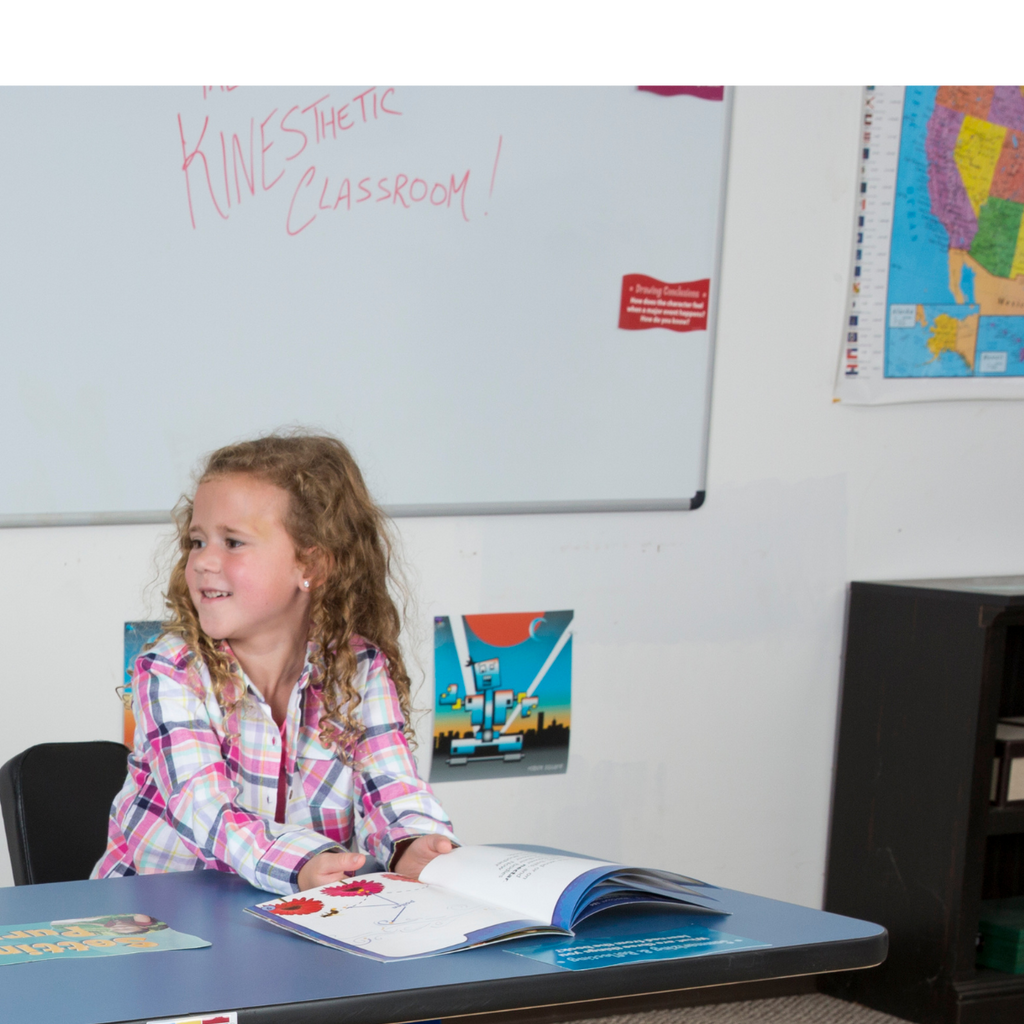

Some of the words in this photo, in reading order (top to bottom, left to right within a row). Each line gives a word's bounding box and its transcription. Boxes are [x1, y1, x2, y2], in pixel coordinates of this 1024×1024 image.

[177, 86, 403, 230] KINESTHETIC
[636, 284, 662, 298] Drawing
[663, 286, 700, 298] Conclusions
